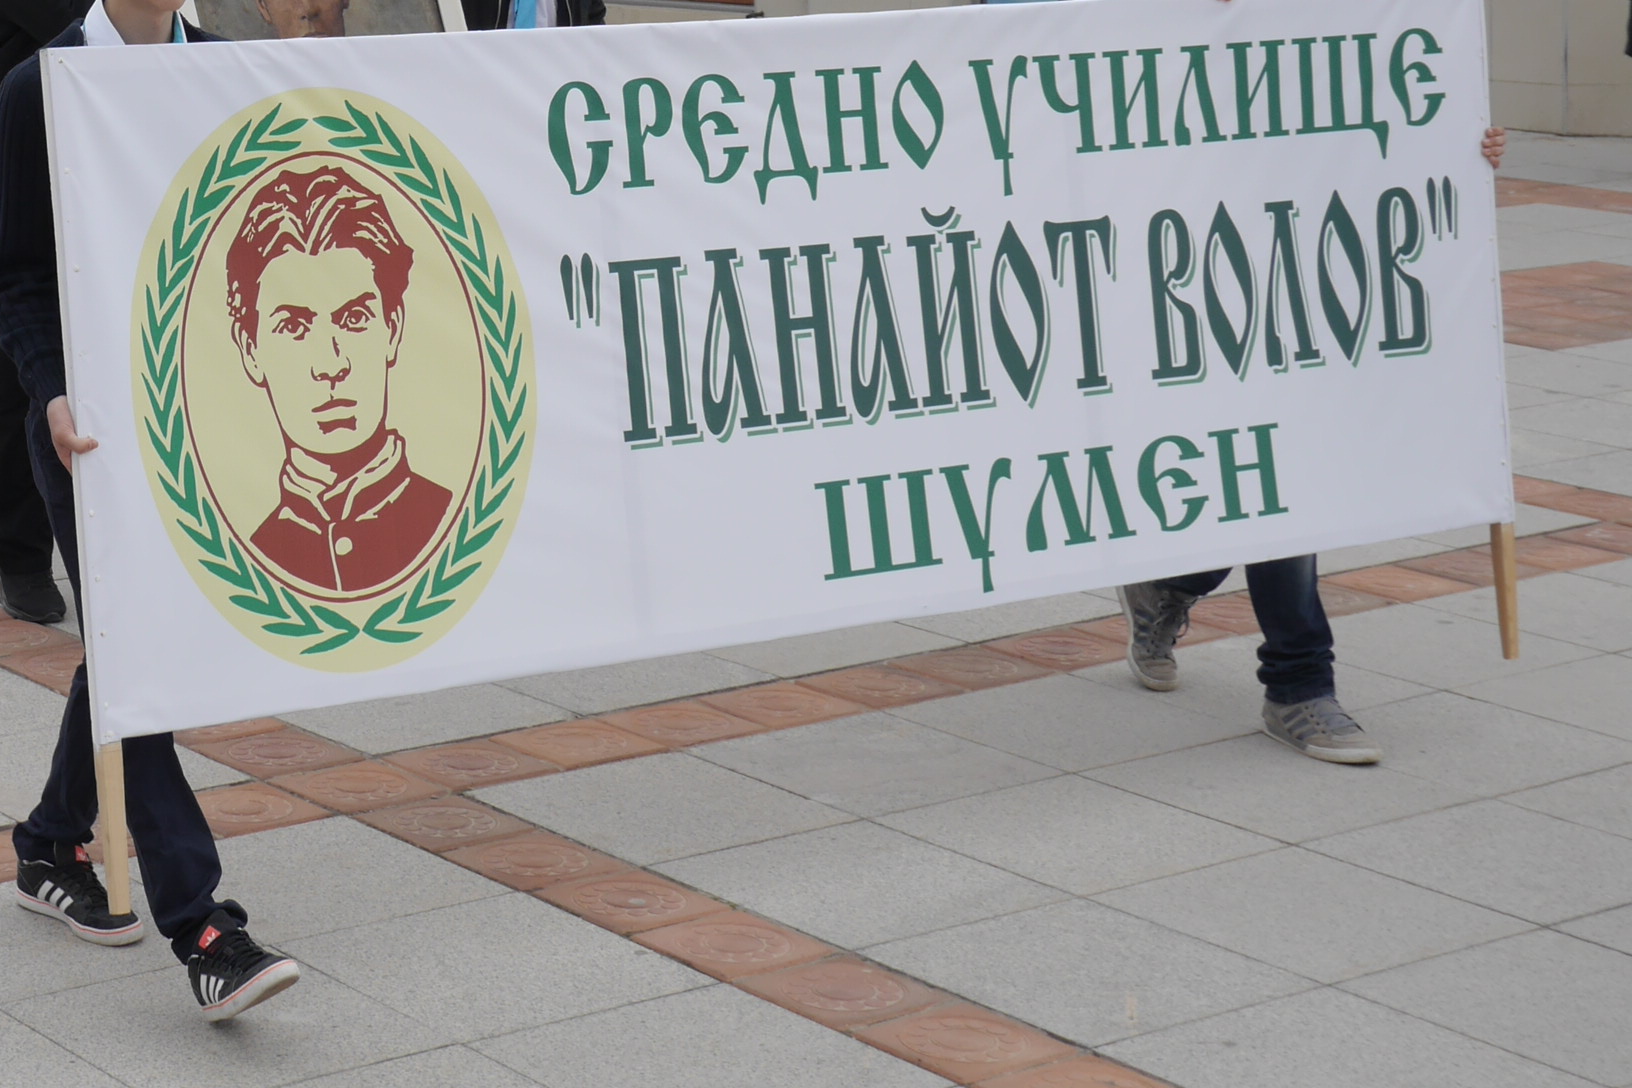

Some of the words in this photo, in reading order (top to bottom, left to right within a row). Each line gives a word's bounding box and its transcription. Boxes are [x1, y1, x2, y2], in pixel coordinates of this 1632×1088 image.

[547, 59, 943, 204] СРЕДНО
[969, 27, 1447, 196] УЧИЛИЩЕ
[560, 206, 1116, 449] "ПАНАЙОТ
[1148, 176, 1459, 385] ВОЛОВ"
[814, 422, 1289, 592] ШУМЕН
